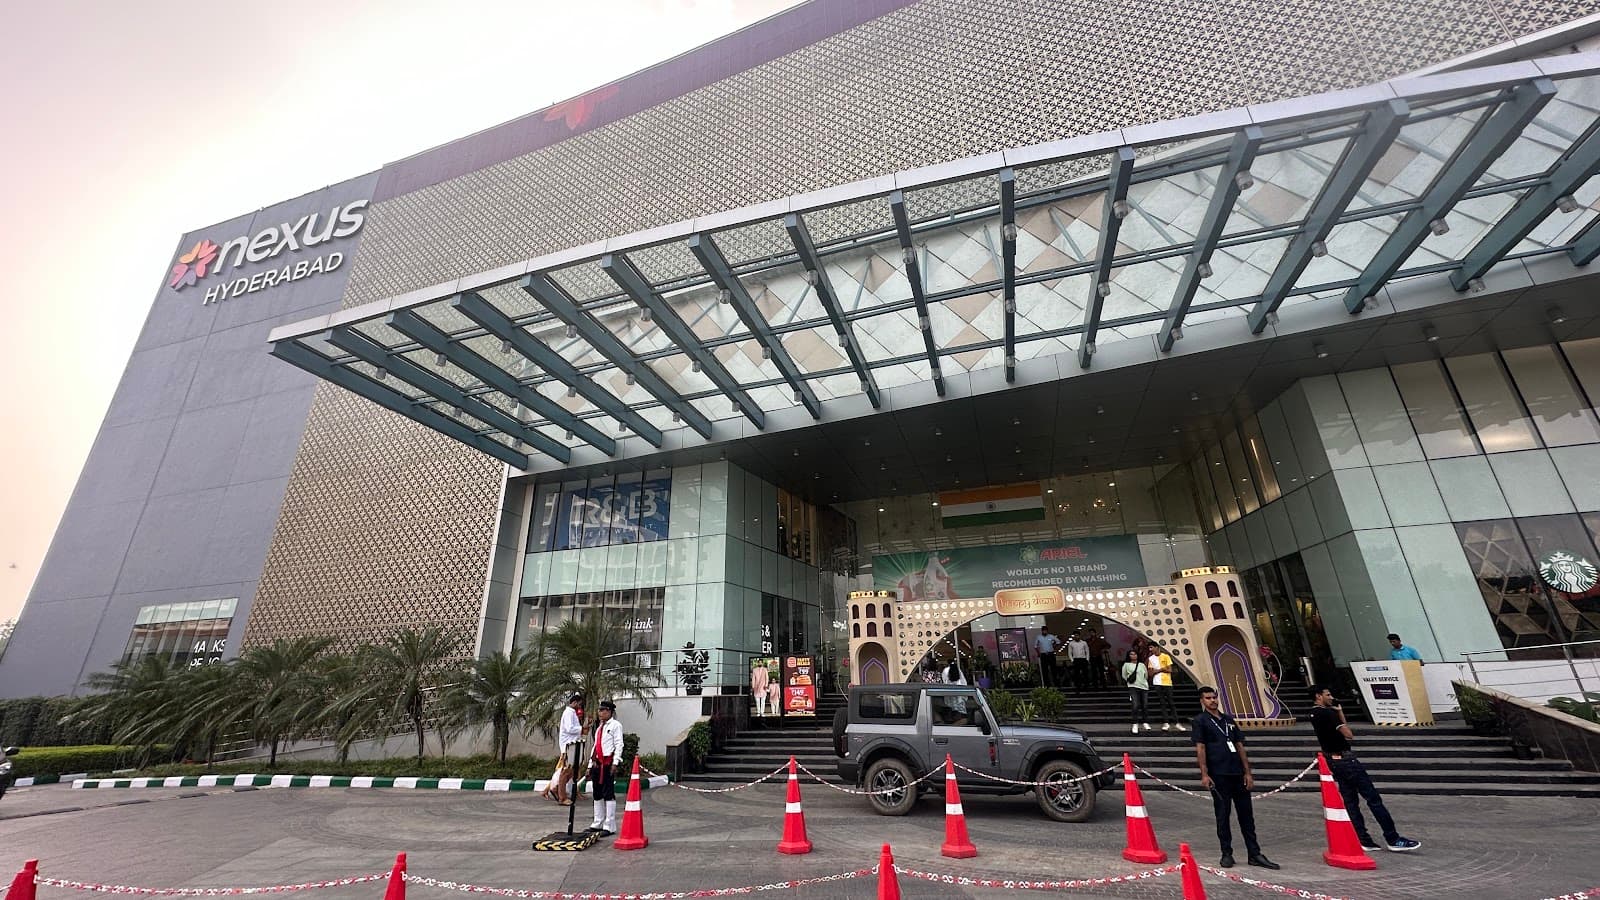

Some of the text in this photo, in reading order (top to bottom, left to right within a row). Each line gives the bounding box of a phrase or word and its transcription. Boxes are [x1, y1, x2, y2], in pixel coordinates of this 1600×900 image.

[212, 199, 370, 275] nexus
[202, 251, 344, 305] HYDERABAD
[571, 488, 658, 525] R&B
[1040, 547, 1088, 560] ARIEL
[992, 573, 1128, 588] RECOMMENDED BY WASHING
[1006, 567, 1050, 577] WORLD'S
[1050, 566, 1066, 575] NO
[1073, 563, 1108, 573] BRAND
